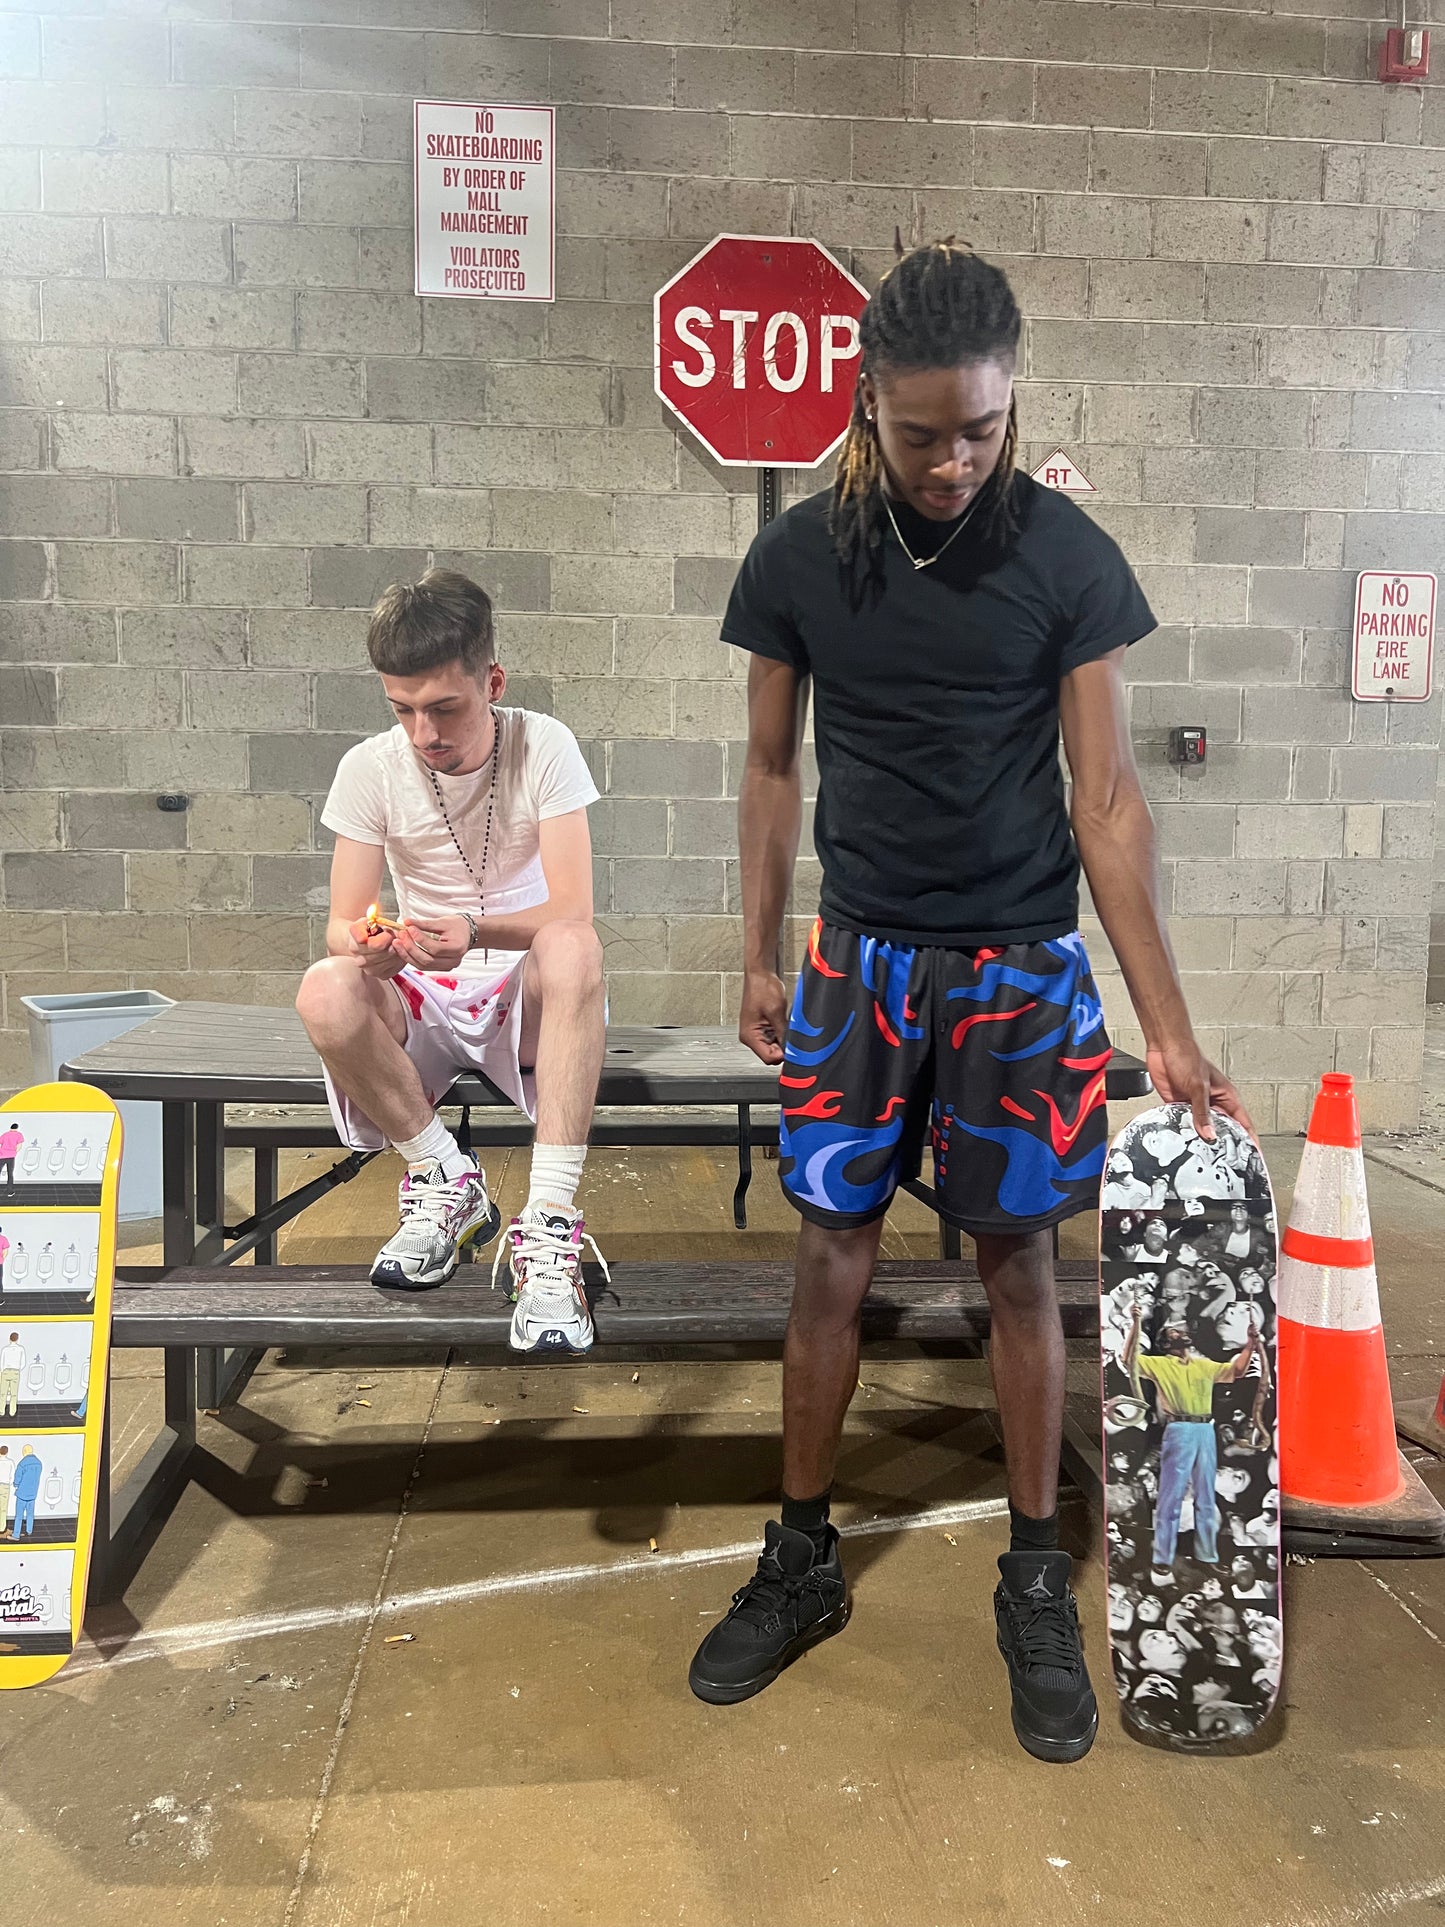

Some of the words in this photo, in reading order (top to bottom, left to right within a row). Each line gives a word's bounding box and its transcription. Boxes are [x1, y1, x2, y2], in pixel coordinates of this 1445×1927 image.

[475, 111, 494, 134] NO
[426, 134, 543, 161] SKATEBOARDING
[443, 167, 460, 187] BY
[464, 168, 506, 190] ORDER
[509, 170, 526, 191] OF
[467, 191, 502, 212] MALL
[440, 212, 529, 235] MANAGEMENT
[450, 246, 520, 269] VIOLATORS
[444, 268, 526, 291] PROSECUTED
[672, 305, 862, 393] STOP
[1045, 468, 1072, 484] RT
[1382, 583, 1409, 607] NO
[1360, 612, 1428, 637] PARKING
[1376, 641, 1409, 658] FIRE
[1373, 662, 1410, 679] LANE
[381, 1260, 396, 1271] 41
[545, 1331, 562, 1344] 41
[0, 1583, 32, 1602] ate
